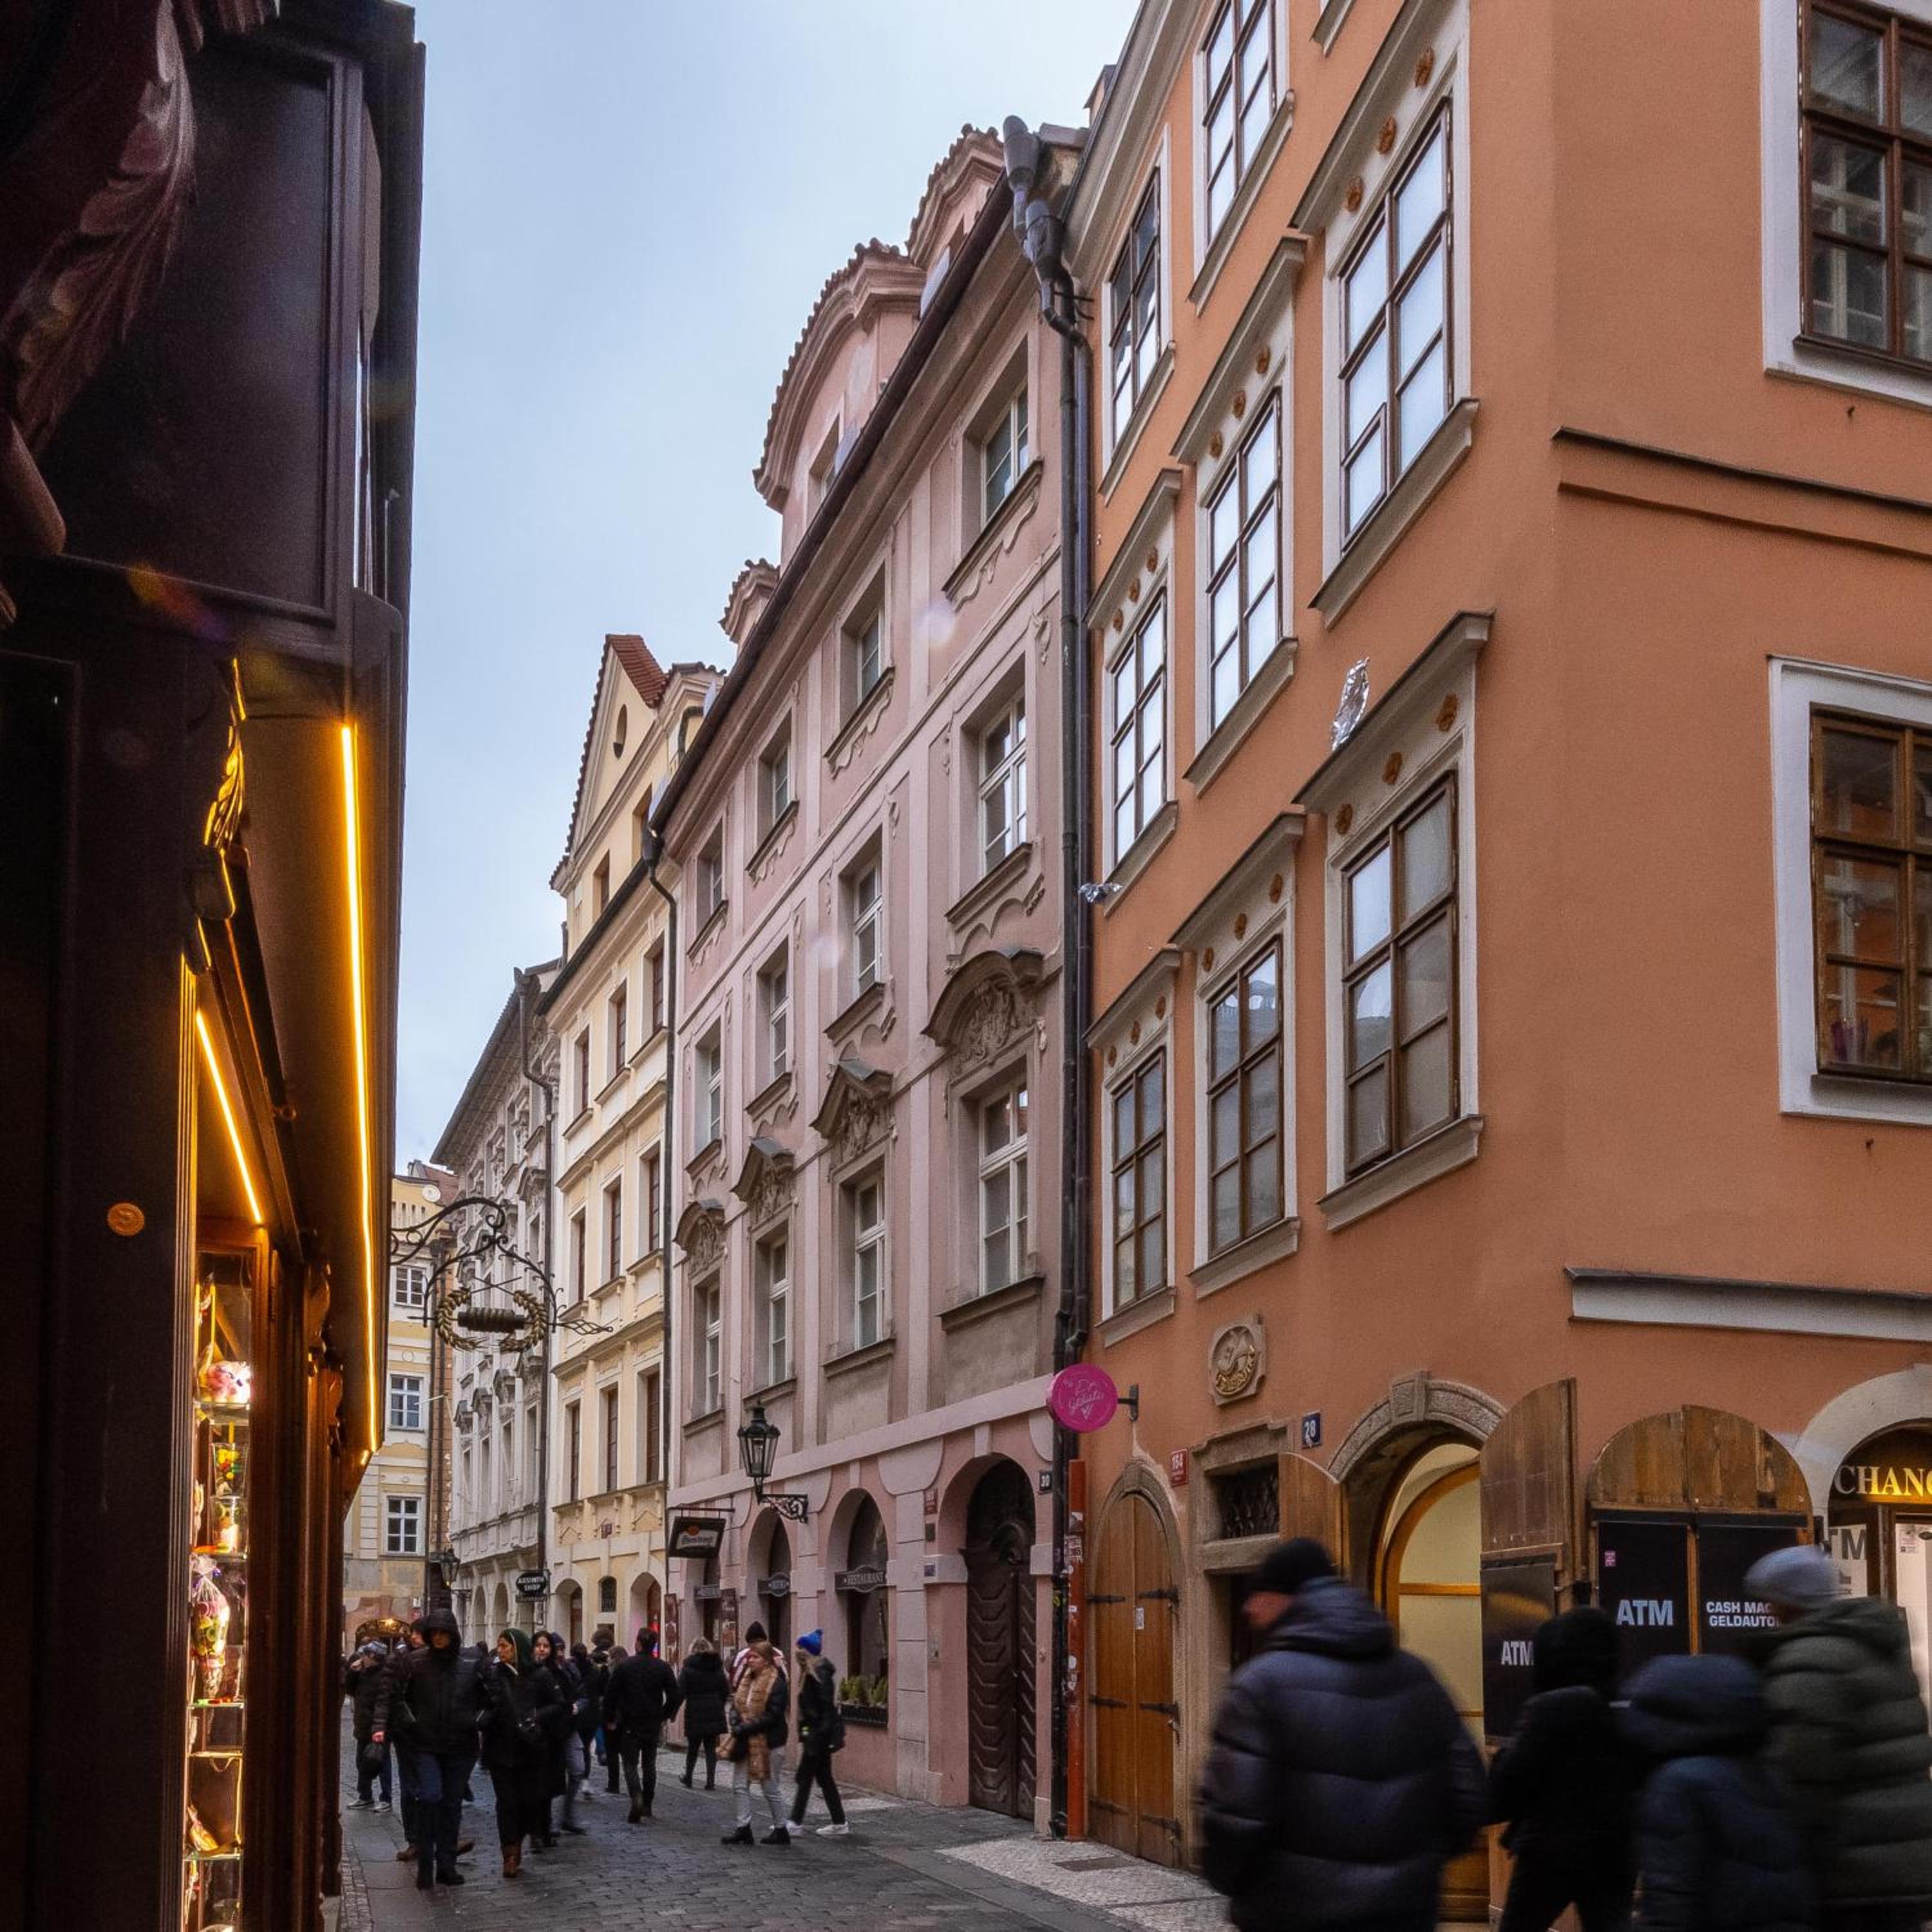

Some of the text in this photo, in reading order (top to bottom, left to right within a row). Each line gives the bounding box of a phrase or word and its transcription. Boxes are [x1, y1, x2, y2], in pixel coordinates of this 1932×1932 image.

[1304, 1419, 1316, 1437] 28
[1834, 1464, 1932, 1497] CHAN
[1829, 1528, 1867, 1560] TM
[1616, 1600, 1673, 1626] ATM
[1707, 1602, 1740, 1613] CASH
[1501, 1640, 1534, 1666] ATM
